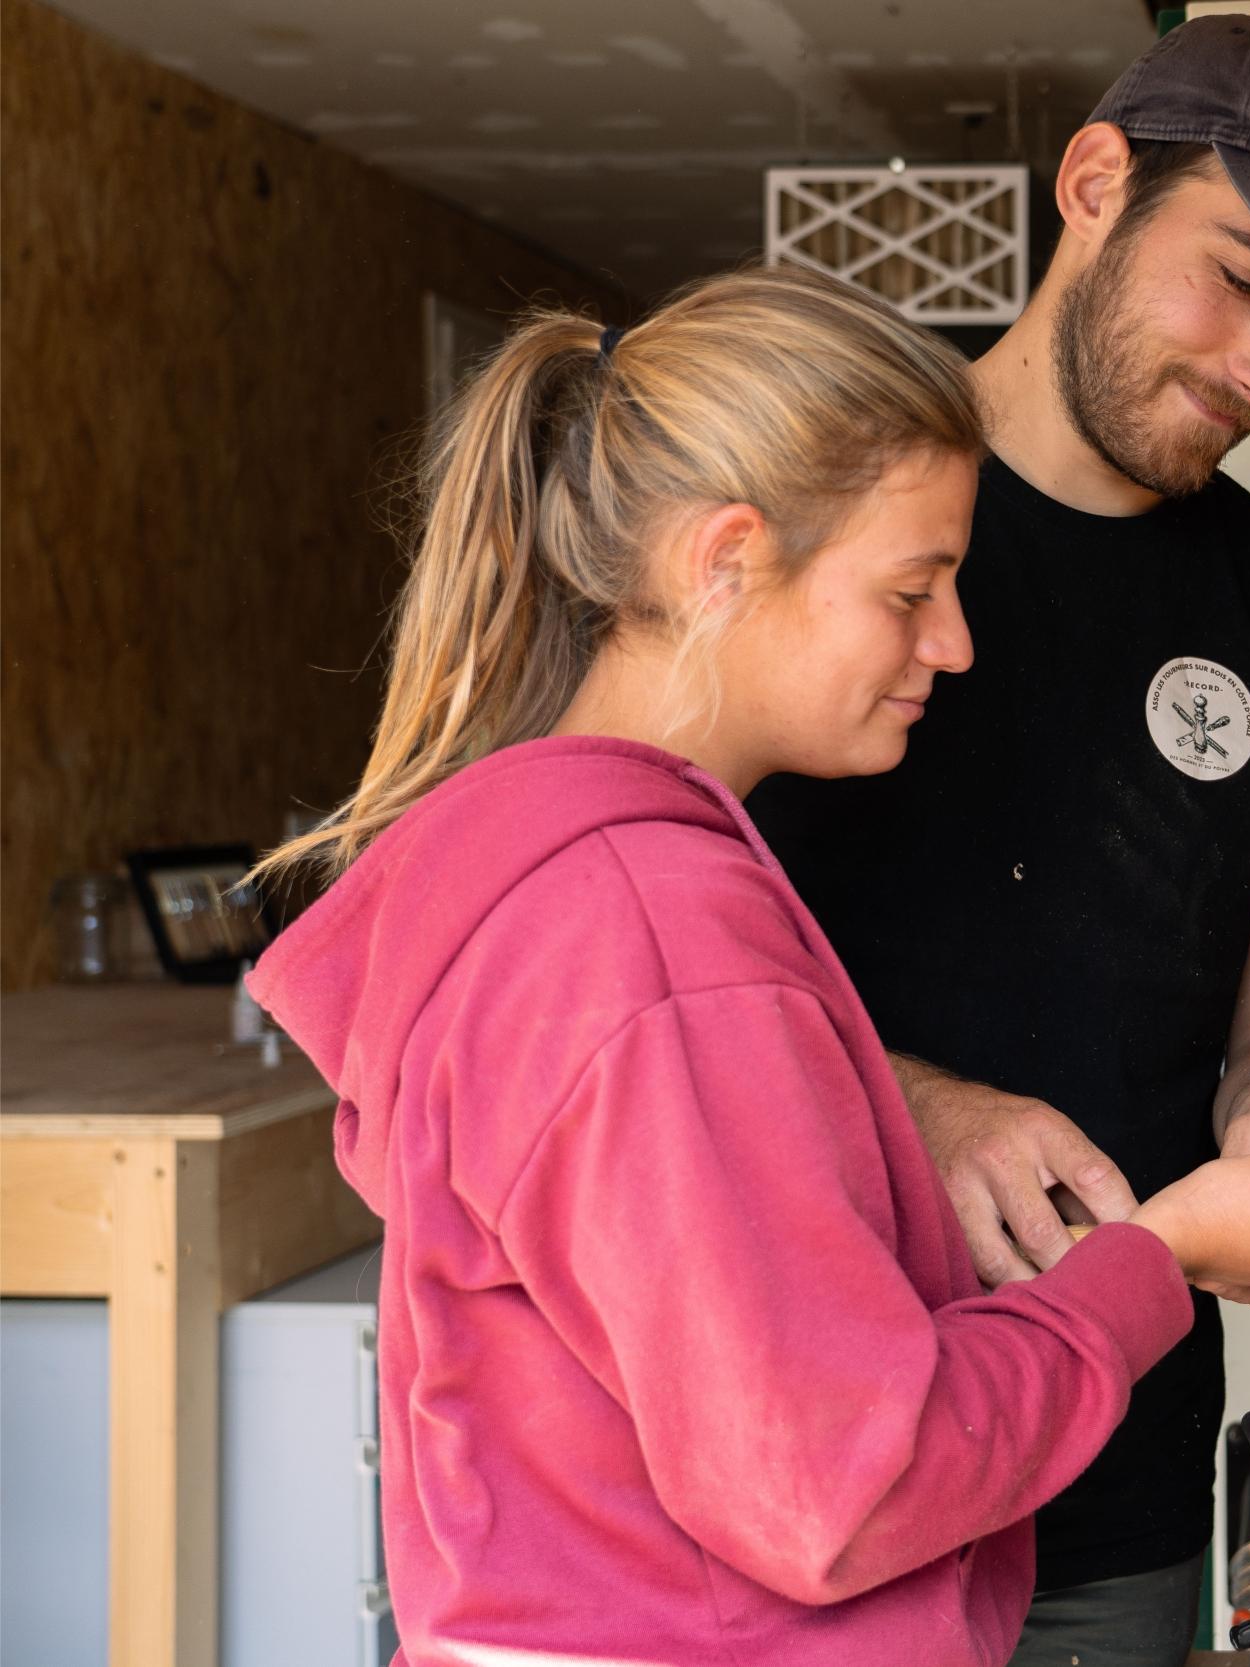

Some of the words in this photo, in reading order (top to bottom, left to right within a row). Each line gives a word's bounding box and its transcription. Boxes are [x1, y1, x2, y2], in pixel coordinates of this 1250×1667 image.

[1152, 691, 1160, 712] ASSO
[1156, 679, 1165, 691] LES
[1194, 663, 1209, 673] SUR
[1210, 668, 1227, 680] BOIS
[1227, 678, 1237, 688] EN
